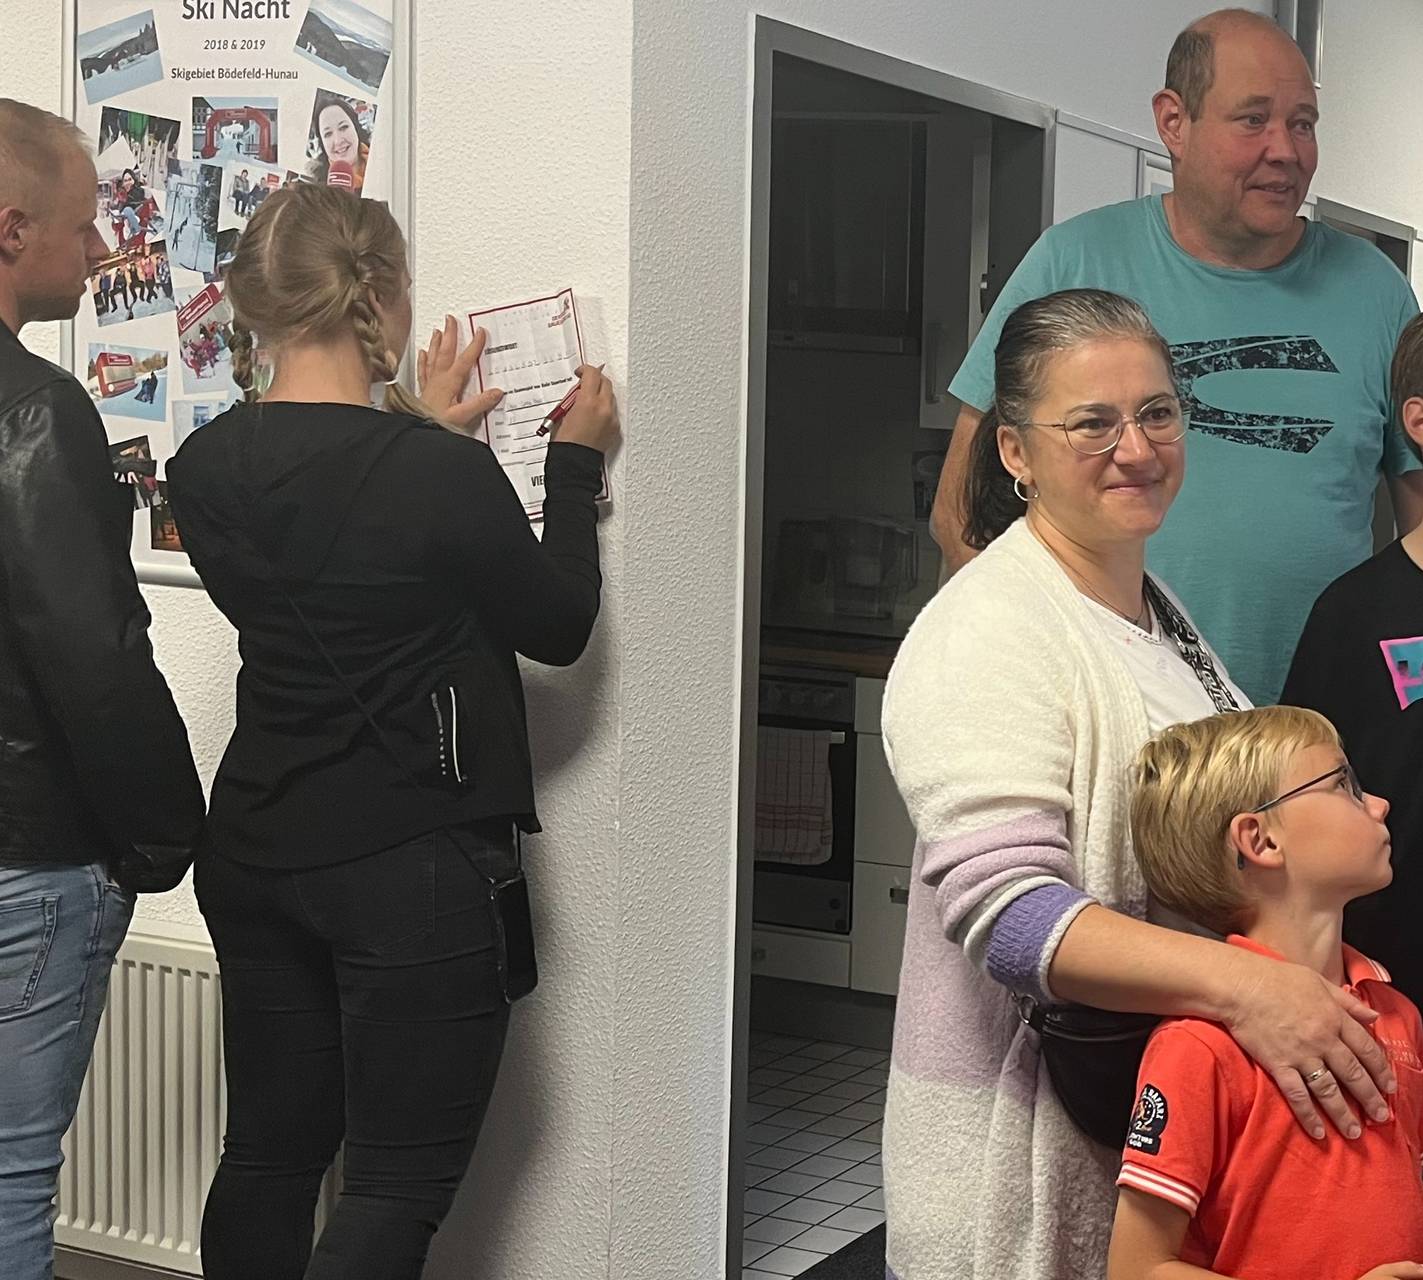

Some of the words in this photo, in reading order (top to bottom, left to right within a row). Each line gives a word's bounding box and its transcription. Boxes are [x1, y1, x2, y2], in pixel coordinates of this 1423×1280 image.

[182, 0, 215, 20] Ski
[222, 0, 290, 19] Nacht
[203, 39, 228, 50] 2018
[230, 39, 238, 50] &
[240, 39, 266, 50] 2019
[171, 68, 215, 81] Skigebiet
[217, 67, 299, 80] Bödefeld-Hunau
